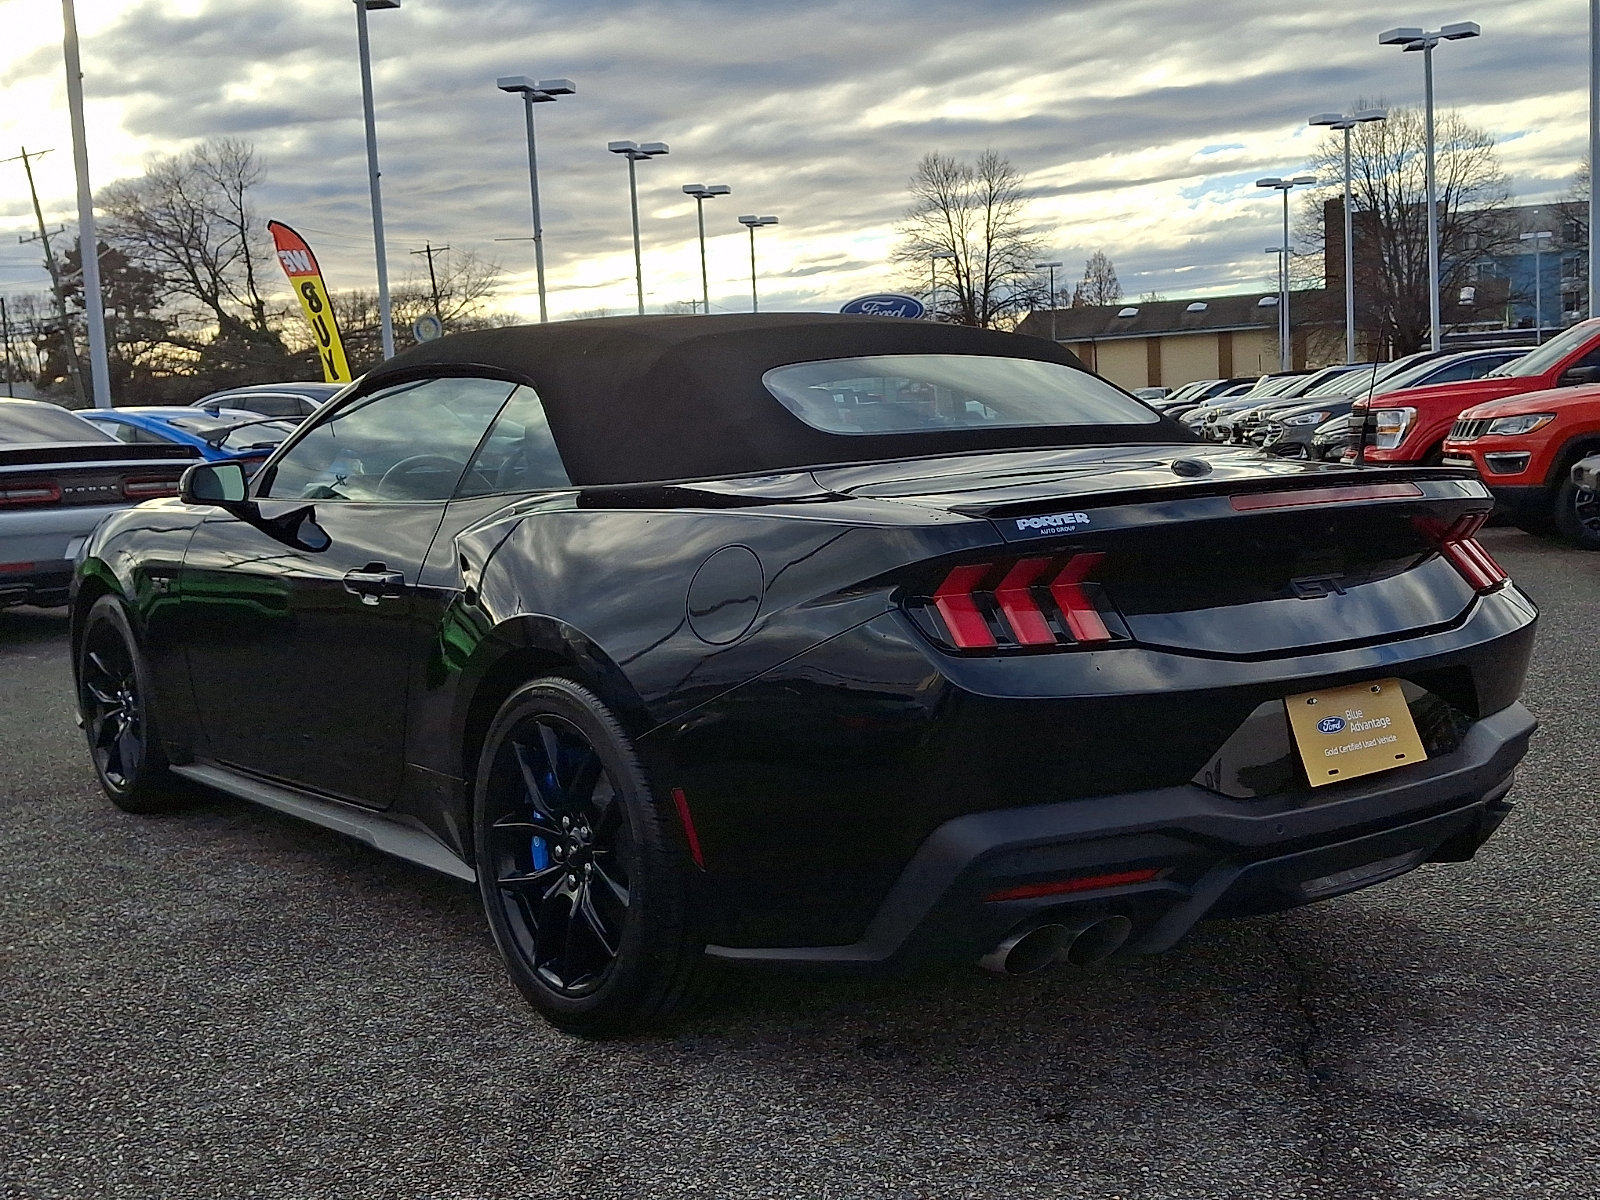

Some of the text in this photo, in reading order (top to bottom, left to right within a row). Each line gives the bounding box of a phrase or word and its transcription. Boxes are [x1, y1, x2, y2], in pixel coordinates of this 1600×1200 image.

[1016, 513, 1090, 530] PORTER
[1040, 525, 1076, 535] AUTO GROUP
[1345, 709, 1363, 720] Blue
[1350, 717, 1391, 732] Advantage
[1324, 735, 1397, 757] Gold Certified Used Vehicle
